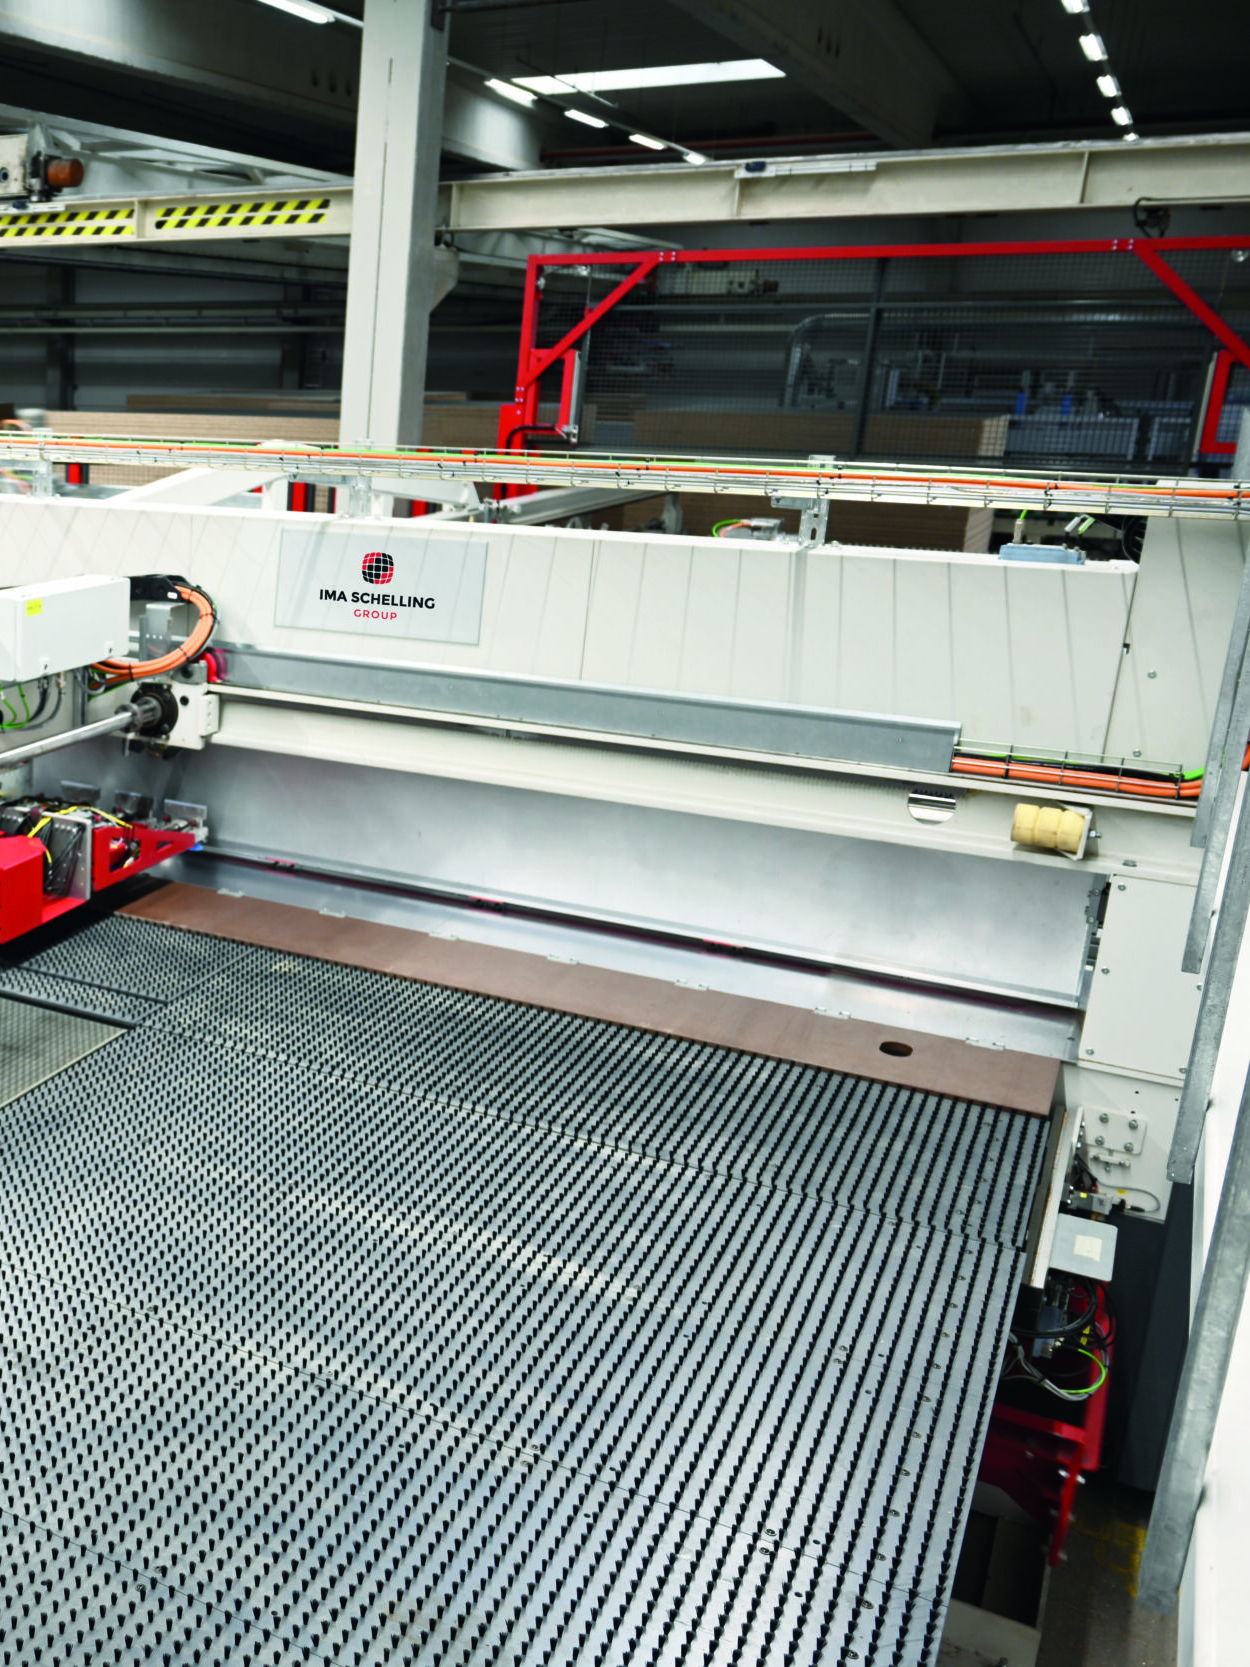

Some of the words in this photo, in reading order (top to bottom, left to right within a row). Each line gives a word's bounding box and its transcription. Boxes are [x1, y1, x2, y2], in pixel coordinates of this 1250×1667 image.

[319, 589, 347, 602] IMA
[351, 591, 435, 609] SCHELLING
[353, 608, 397, 620] GROUP
